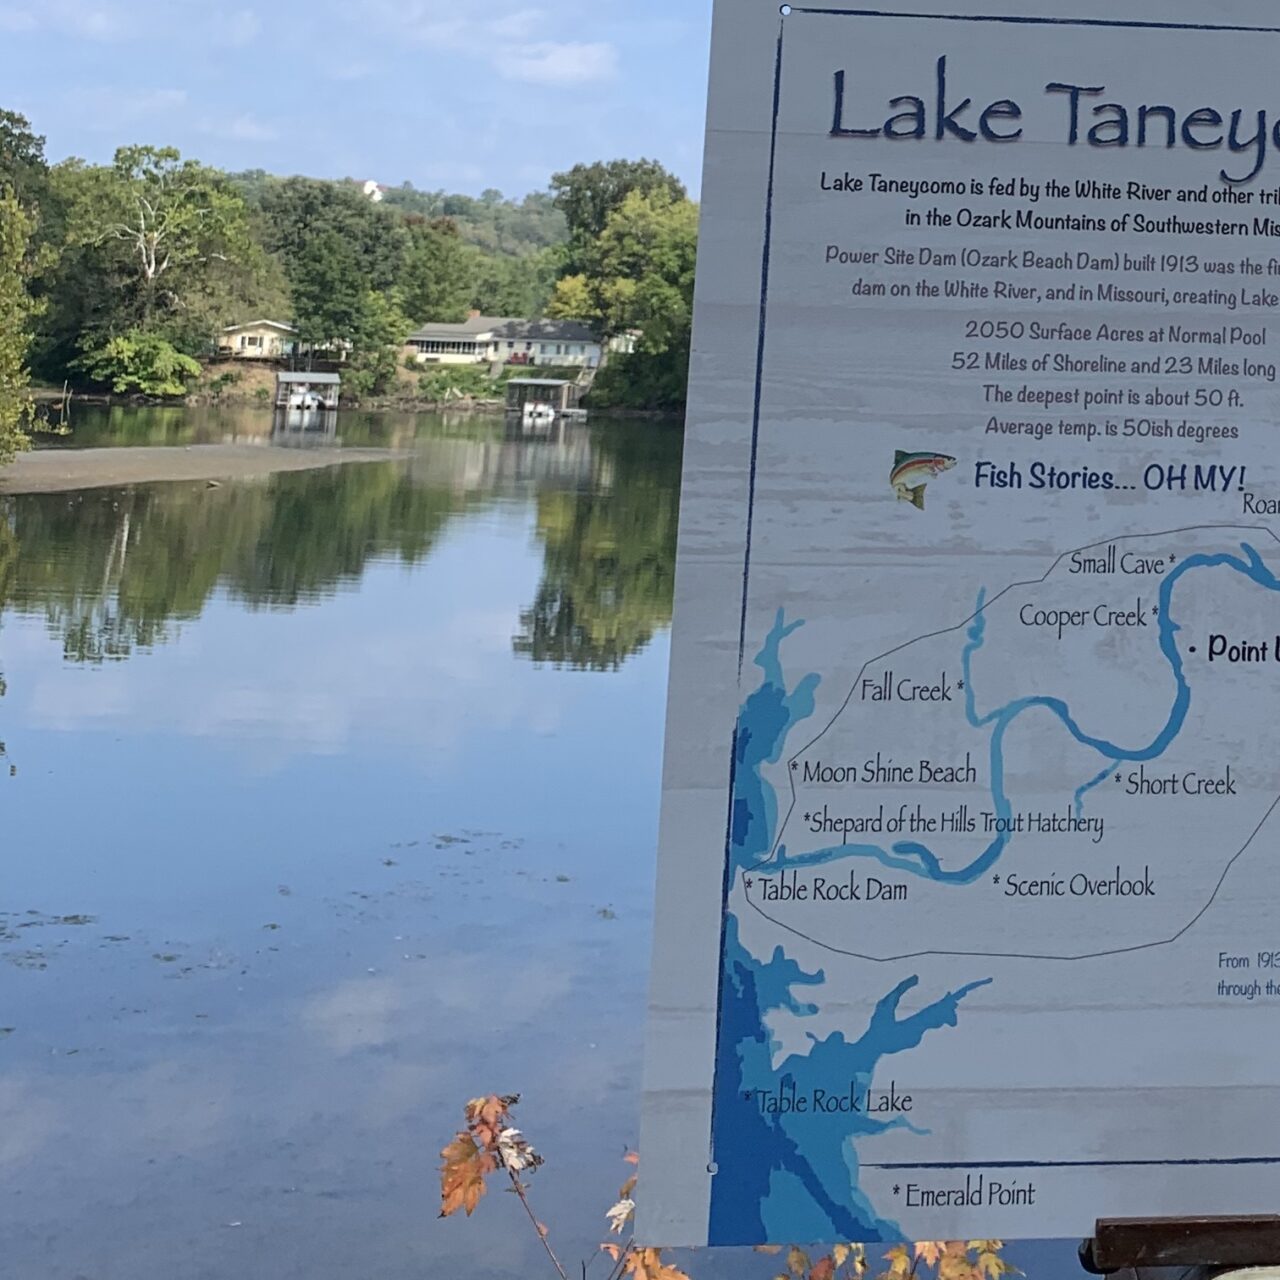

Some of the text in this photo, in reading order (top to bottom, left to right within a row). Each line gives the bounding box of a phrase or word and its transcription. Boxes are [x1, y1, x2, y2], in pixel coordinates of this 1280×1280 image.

[829, 55, 1023, 142] Lake
[820, 172, 863, 192] Lake
[869, 174, 966, 198] Taneycomo
[970, 179, 983, 195] is
[989, 177, 1015, 197] fed
[1020, 179, 1039, 202] by
[1045, 179, 1070, 198] the
[1075, 180, 1121, 200] White
[1127, 182, 1171, 201] River
[1177, 185, 1207, 203] and
[1212, 186, 1253, 205] other
[906, 209, 921, 226] in
[926, 208, 952, 226] the
[957, 209, 1012, 229] Ozark
[1016, 210, 1106, 231] Mountains
[1111, 214, 1130, 232] of
[1133, 214, 1248, 236] Southwestern
[965, 321, 1266, 346] 2050 Surface Acres at Normal Pool
[974, 461, 1022, 489] Fish
[1143, 464, 1186, 491] OH
[1195, 466, 1246, 492] MY!
[1069, 545, 1164, 573] Small Cave
[1020, 597, 1147, 640] Cooper Creek
[1208, 634, 1268, 662] Point
[861, 672, 951, 701] Fall Creek
[804, 752, 976, 782] Moon Shine Beach
[1125, 765, 1236, 794] Short Creek
[809, 805, 1104, 845] Shepard of the Hills Trout Hatchery
[758, 870, 907, 900] Table Rock Dam
[1004, 866, 1155, 896] Scenic Overlook
[1219, 952, 1249, 969] From
[757, 1080, 913, 1113] Table Rock Lake
[906, 1174, 1035, 1207] Emerald Point
